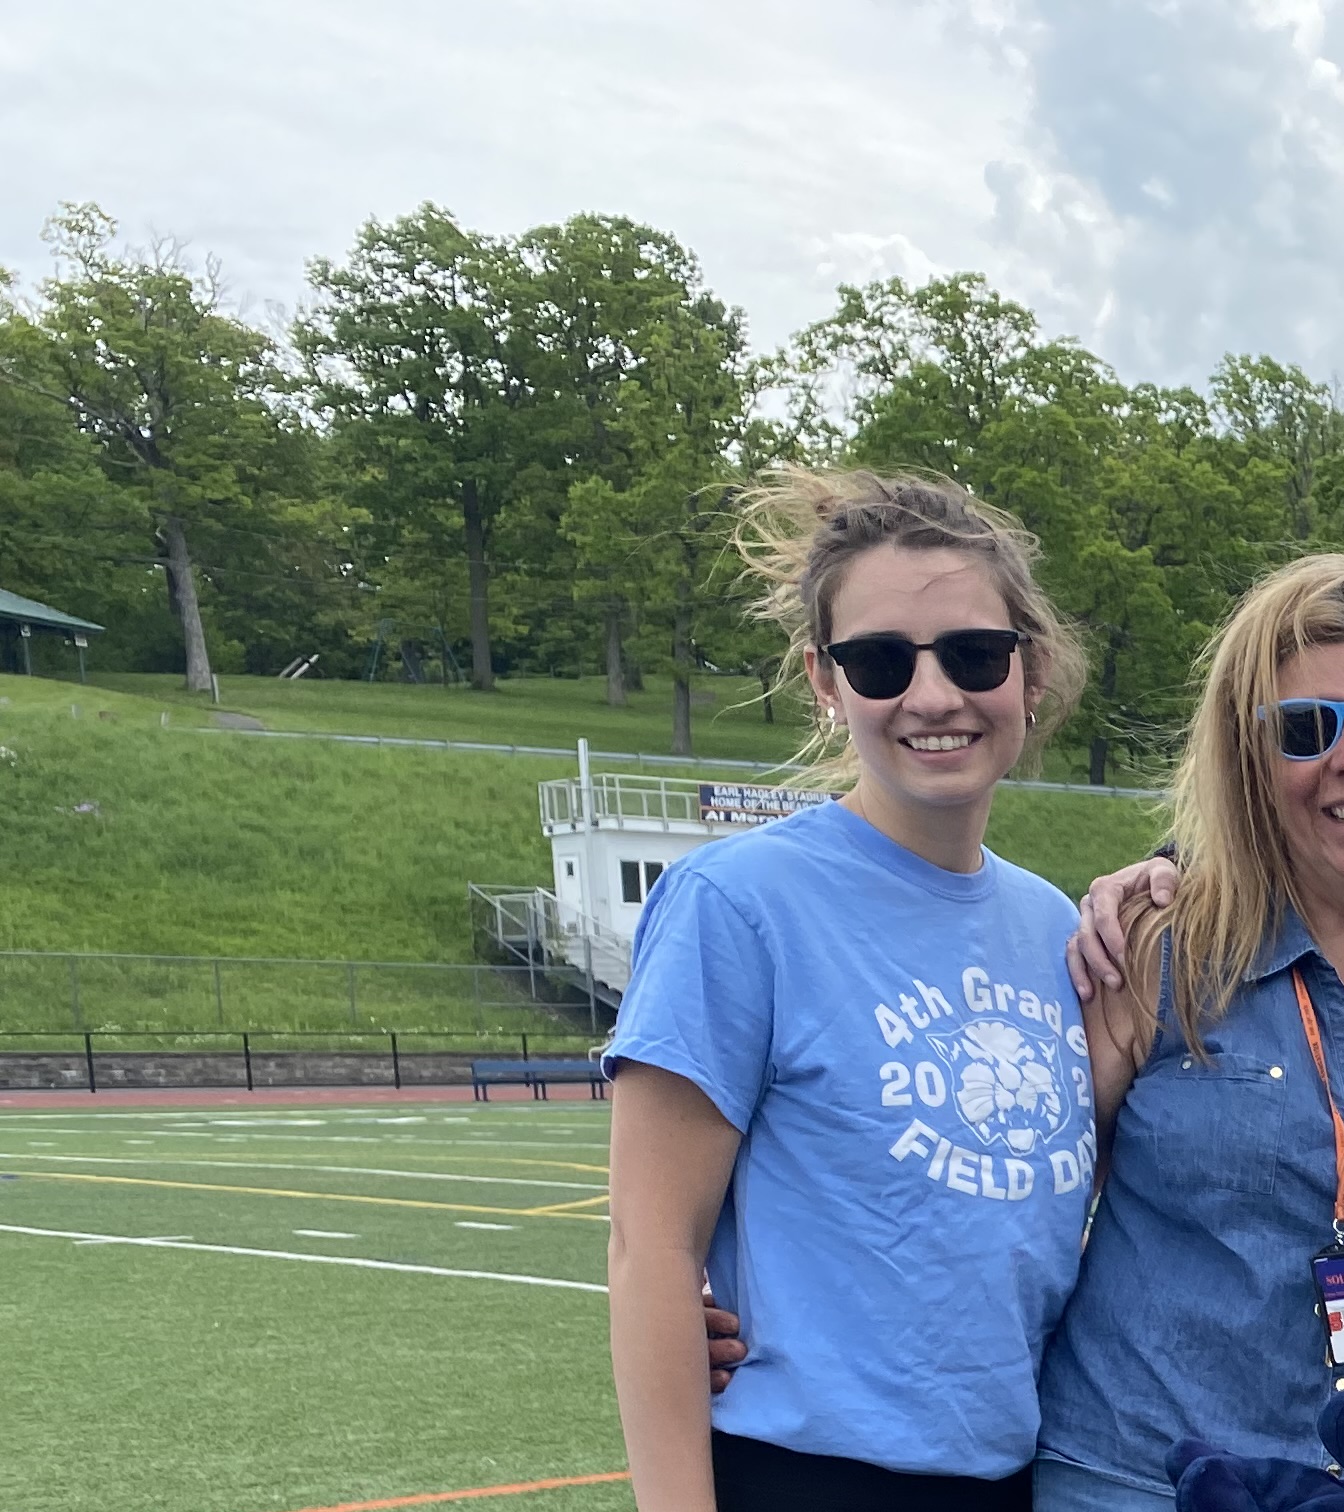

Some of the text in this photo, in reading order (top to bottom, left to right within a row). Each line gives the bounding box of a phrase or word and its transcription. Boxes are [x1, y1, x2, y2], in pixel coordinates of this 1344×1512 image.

[711, 796, 741, 808] HOME
[760, 799, 781, 811] THE
[714, 785, 742, 797] EARL
[874, 966, 1089, 1057] 4th Grade
[879, 1061, 946, 1108] 20
[888, 1118, 1035, 1201] FIELD
